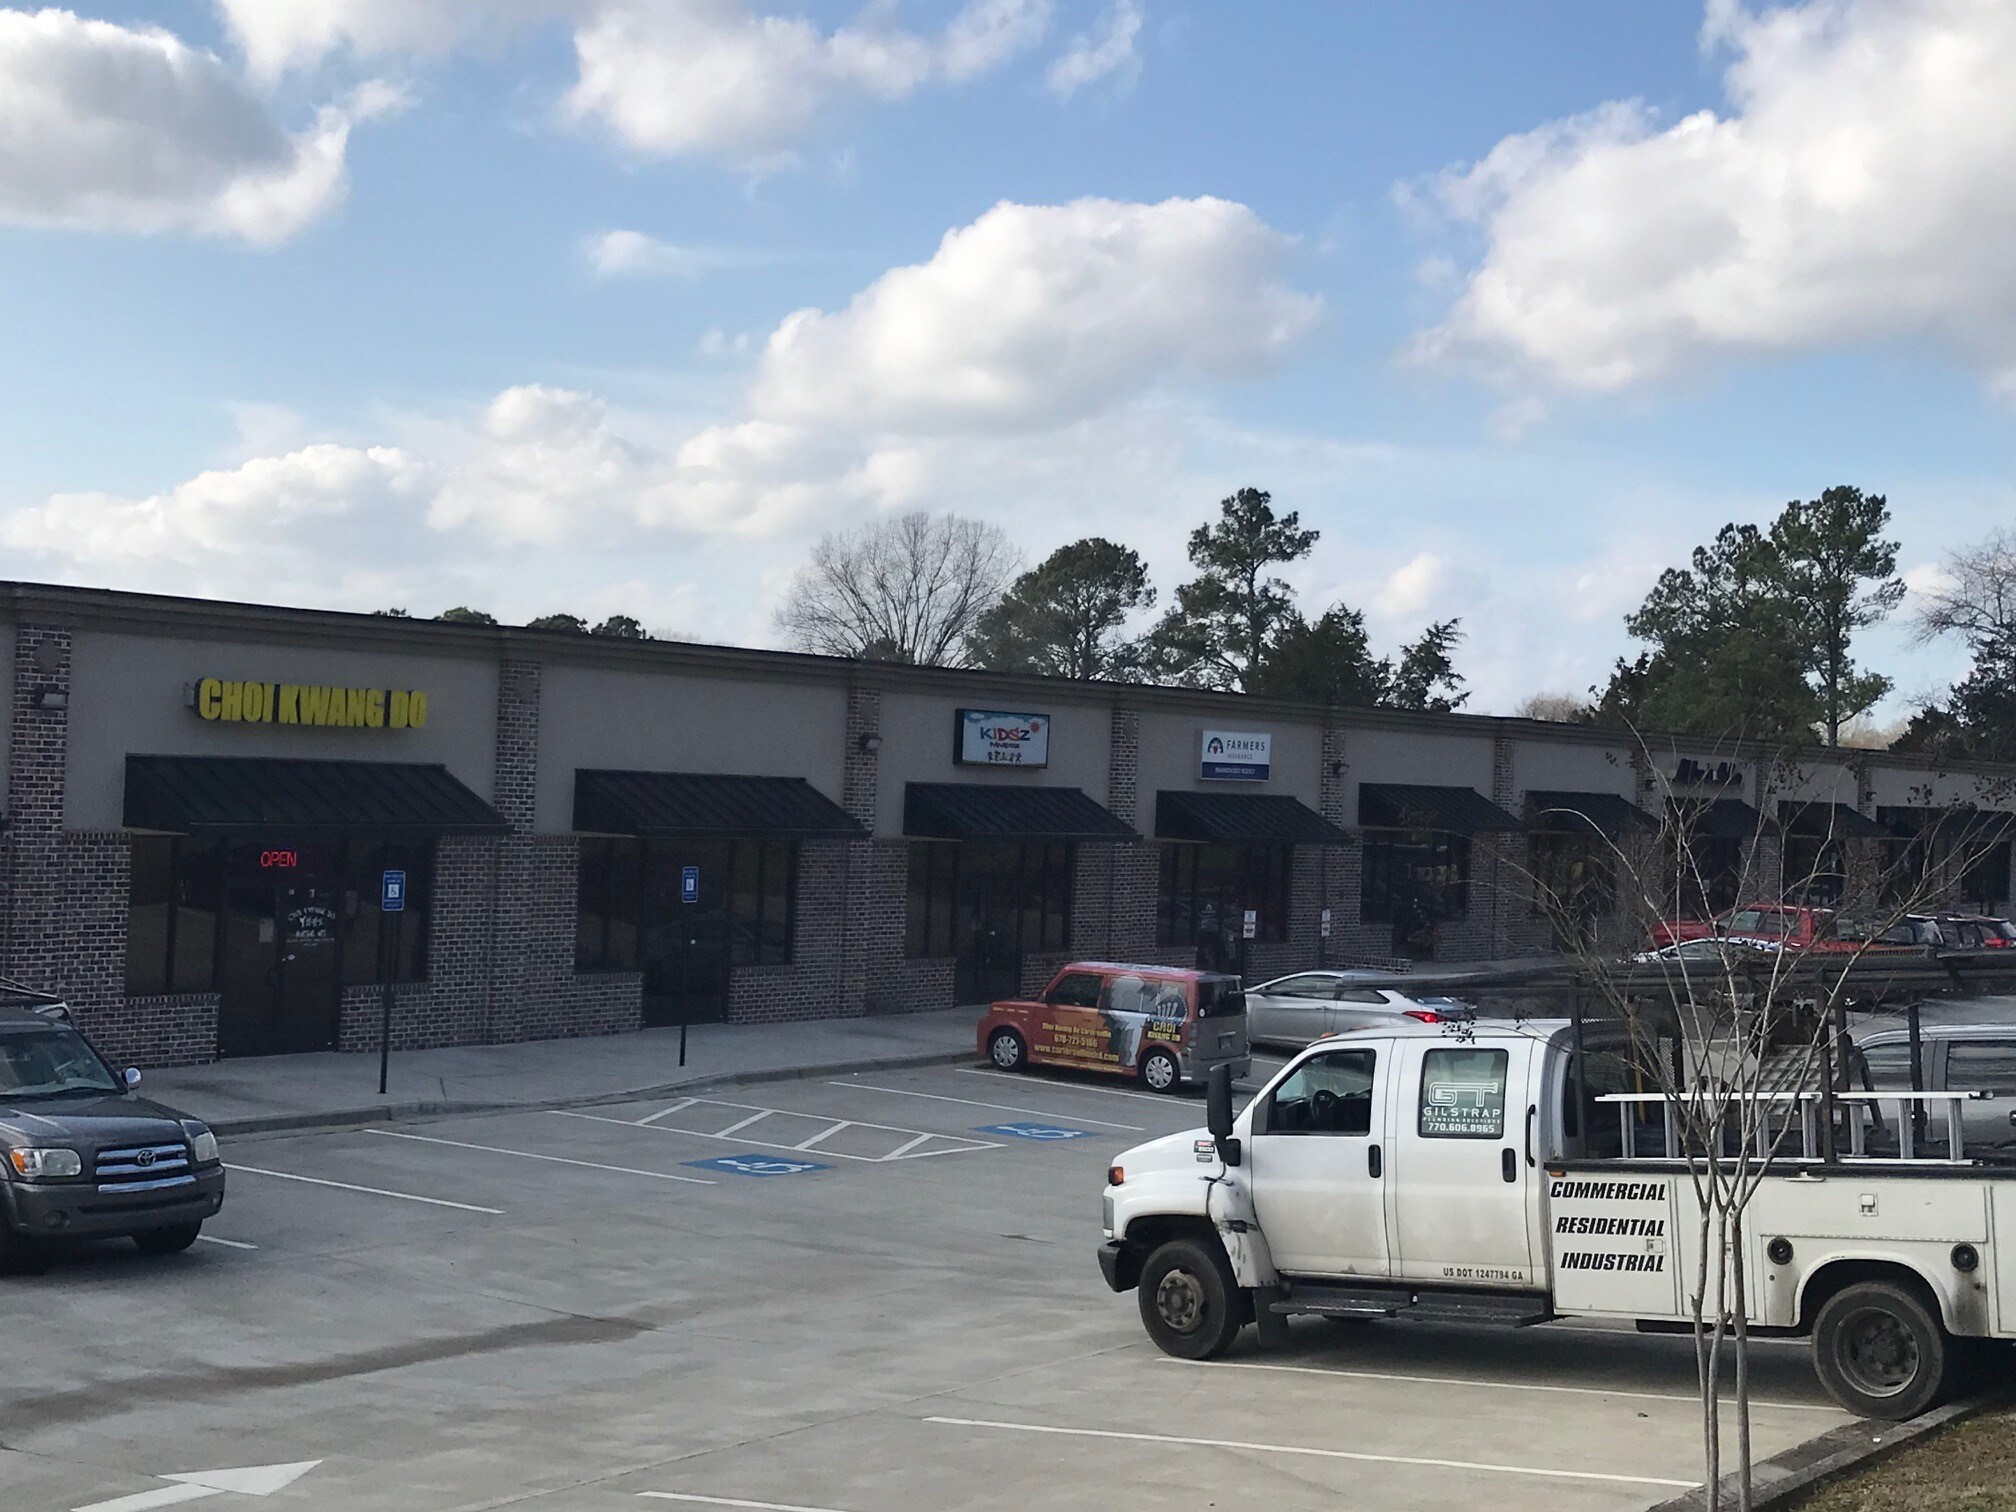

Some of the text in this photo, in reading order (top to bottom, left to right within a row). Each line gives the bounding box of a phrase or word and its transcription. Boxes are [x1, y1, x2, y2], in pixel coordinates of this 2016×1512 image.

[199, 678, 427, 728] CHOI KWANG DO
[1226, 740, 1266, 752] FARMERS
[260, 851, 297, 867] OPEN
[1152, 1020, 1176, 1033] CHOI
[1423, 1106, 1501, 1118] GILSTRAP
[1428, 1122, 1495, 1133] 770.606.8965
[1550, 1181, 1666, 1201] COMMERCIAL
[1556, 1216, 1665, 1237] RESIDENTIAL
[1561, 1252, 1664, 1272] INDUSTRIAL
[1443, 1267, 1523, 1280] US DOT 1247794 GA
